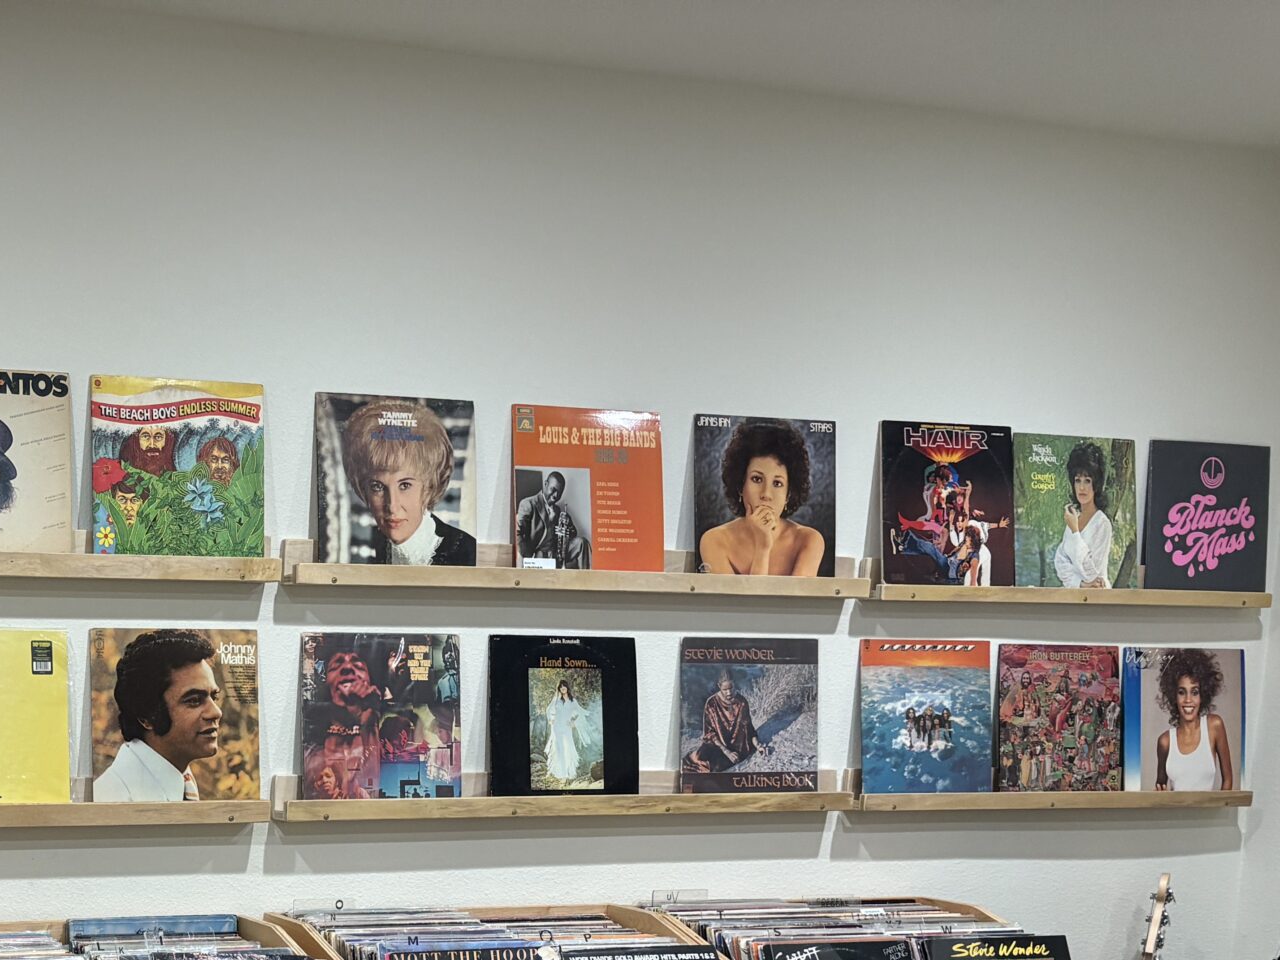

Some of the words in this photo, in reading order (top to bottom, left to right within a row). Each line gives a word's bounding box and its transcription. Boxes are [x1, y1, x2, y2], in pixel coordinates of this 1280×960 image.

[100, 405, 118, 418] THE
[120, 408, 150, 420] BEACH
[153, 406, 177, 419] BOYS
[179, 401, 218, 416] ENDLESS
[219, 403, 257, 417] SUMMER
[381, 411, 412, 419] TAMMY
[809, 423, 833, 433] STARS
[539, 426, 569, 444] LOUIS
[571, 428, 580, 444] &
[581, 428, 601, 446] THE
[604, 429, 621, 446] BIG
[622, 430, 656, 448] BANDS
[904, 427, 988, 449] HAIR
[1172, 528, 1246, 570] Mass
[216, 642, 256, 655] Johnny
[221, 653, 256, 665] Mathis
[1029, 652, 1049, 661] IRON
[1050, 651, 1091, 661] BUTTERFLY
[539, 657, 562, 668] Hand
[774, 928, 782, 936] S
[408, 936, 419, 946] M
[950, 941, 996, 957] Stevie
[999, 941, 1050, 957] Wonder
